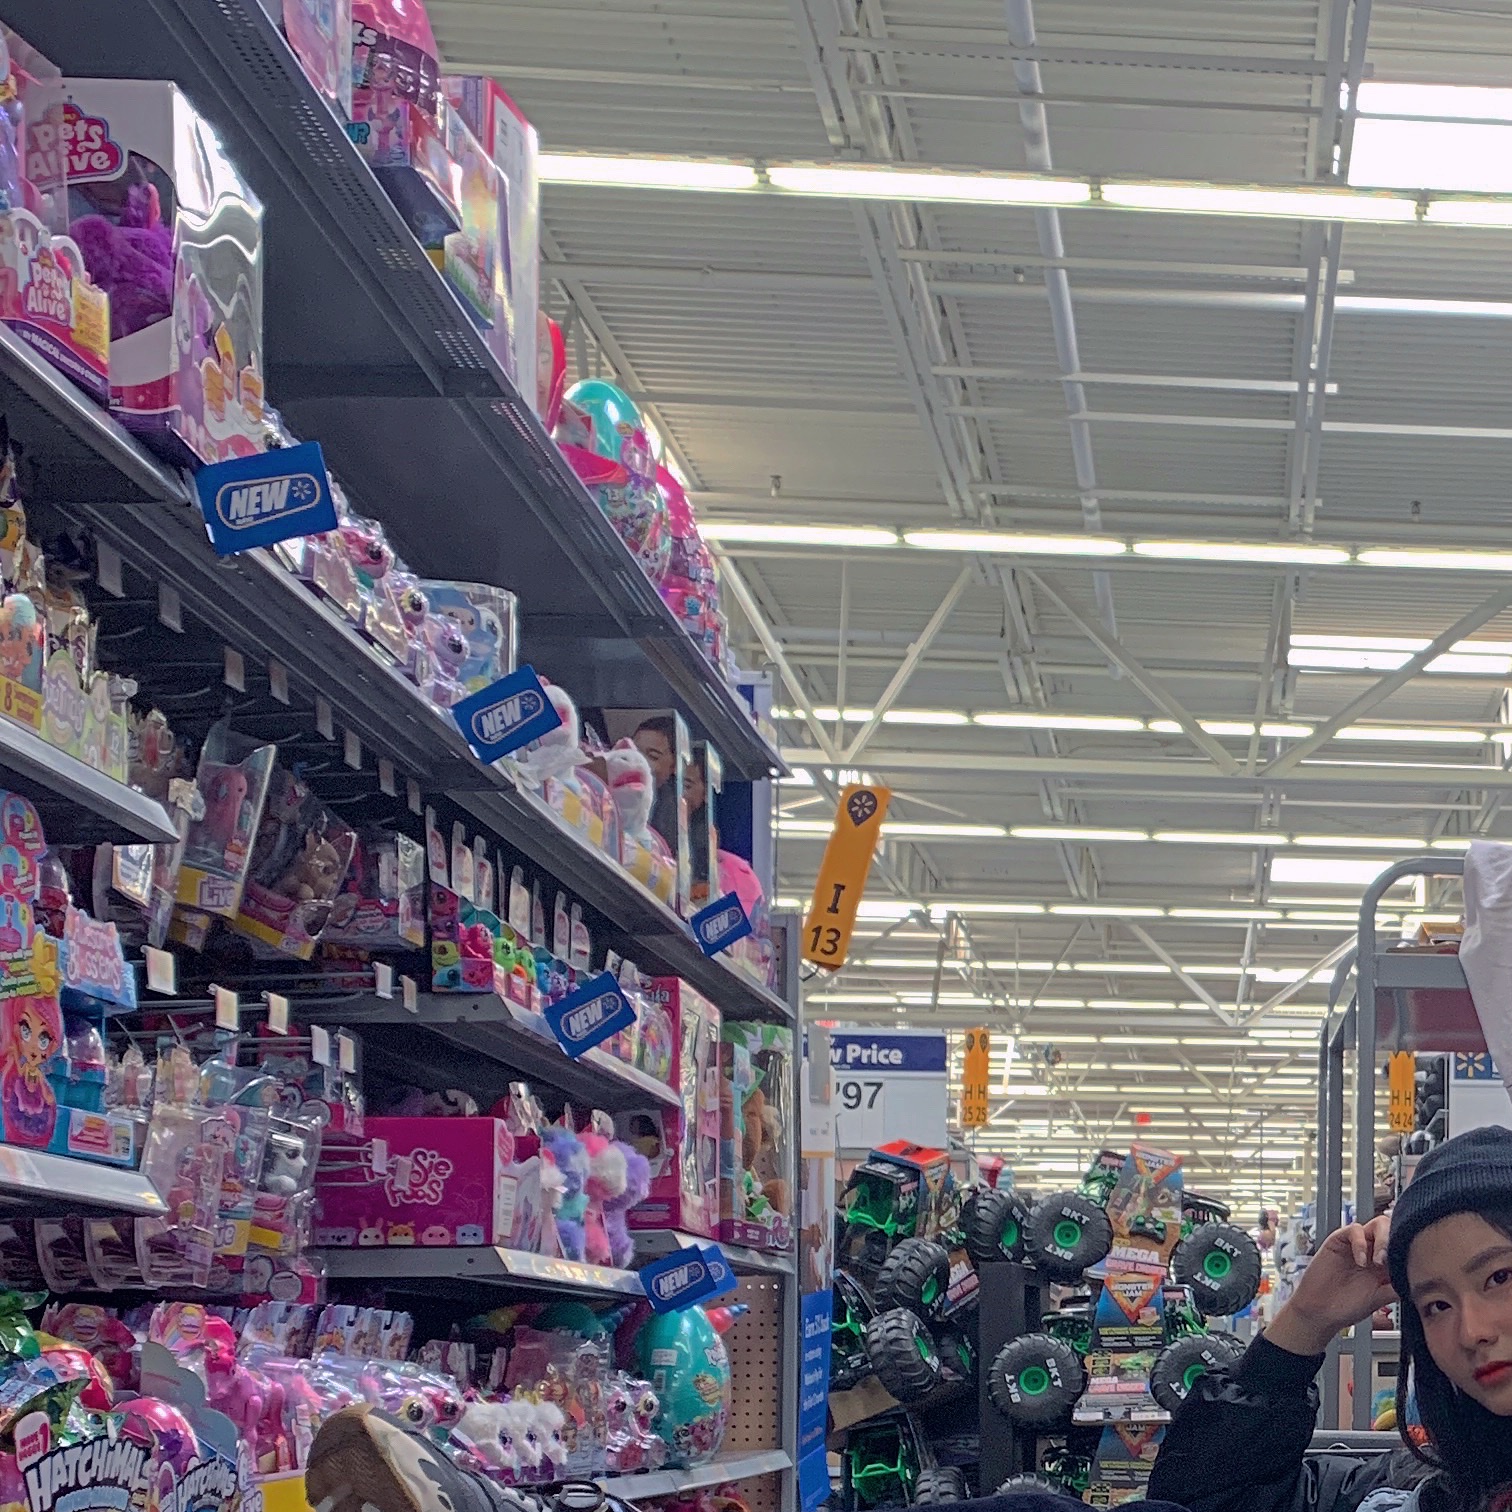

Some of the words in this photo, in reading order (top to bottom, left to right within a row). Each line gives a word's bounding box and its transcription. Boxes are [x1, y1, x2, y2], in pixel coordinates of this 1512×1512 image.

[32, 119, 103, 151] Pets
[29, 150, 111, 180] Alive
[27, 292, 66, 320] Alive
[229, 480, 289, 520] NEW
[481, 695, 522, 739] NEW
[826, 883, 846, 914] I
[701, 911, 732, 942] NEW
[809, 926, 843, 957] 13
[568, 999, 603, 1030] NEW
[846, 1043, 903, 1065] Price
[837, 1081, 884, 1110] 97
[965, 1084, 973, 1100] H
[978, 1084, 986, 1100] H
[1392, 1090, 1400, 1107] H
[1404, 1089, 1412, 1107] H
[963, 1107, 973, 1123] 25
[976, 1106, 987, 1123] 25
[1390, 1113, 1401, 1126] 24
[1403, 1112, 1413, 1126] 24
[1060, 1206, 1090, 1225] BKT
[1044, 1243, 1074, 1260] BKT
[1111, 1245, 1160, 1264] MEGA
[1214, 1237, 1242, 1257] BKT
[659, 1266, 689, 1297] NEW
[1192, 1271, 1222, 1292] BKT
[1046, 1357, 1063, 1388] BKT
[1004, 1372, 1022, 1404] BKT
